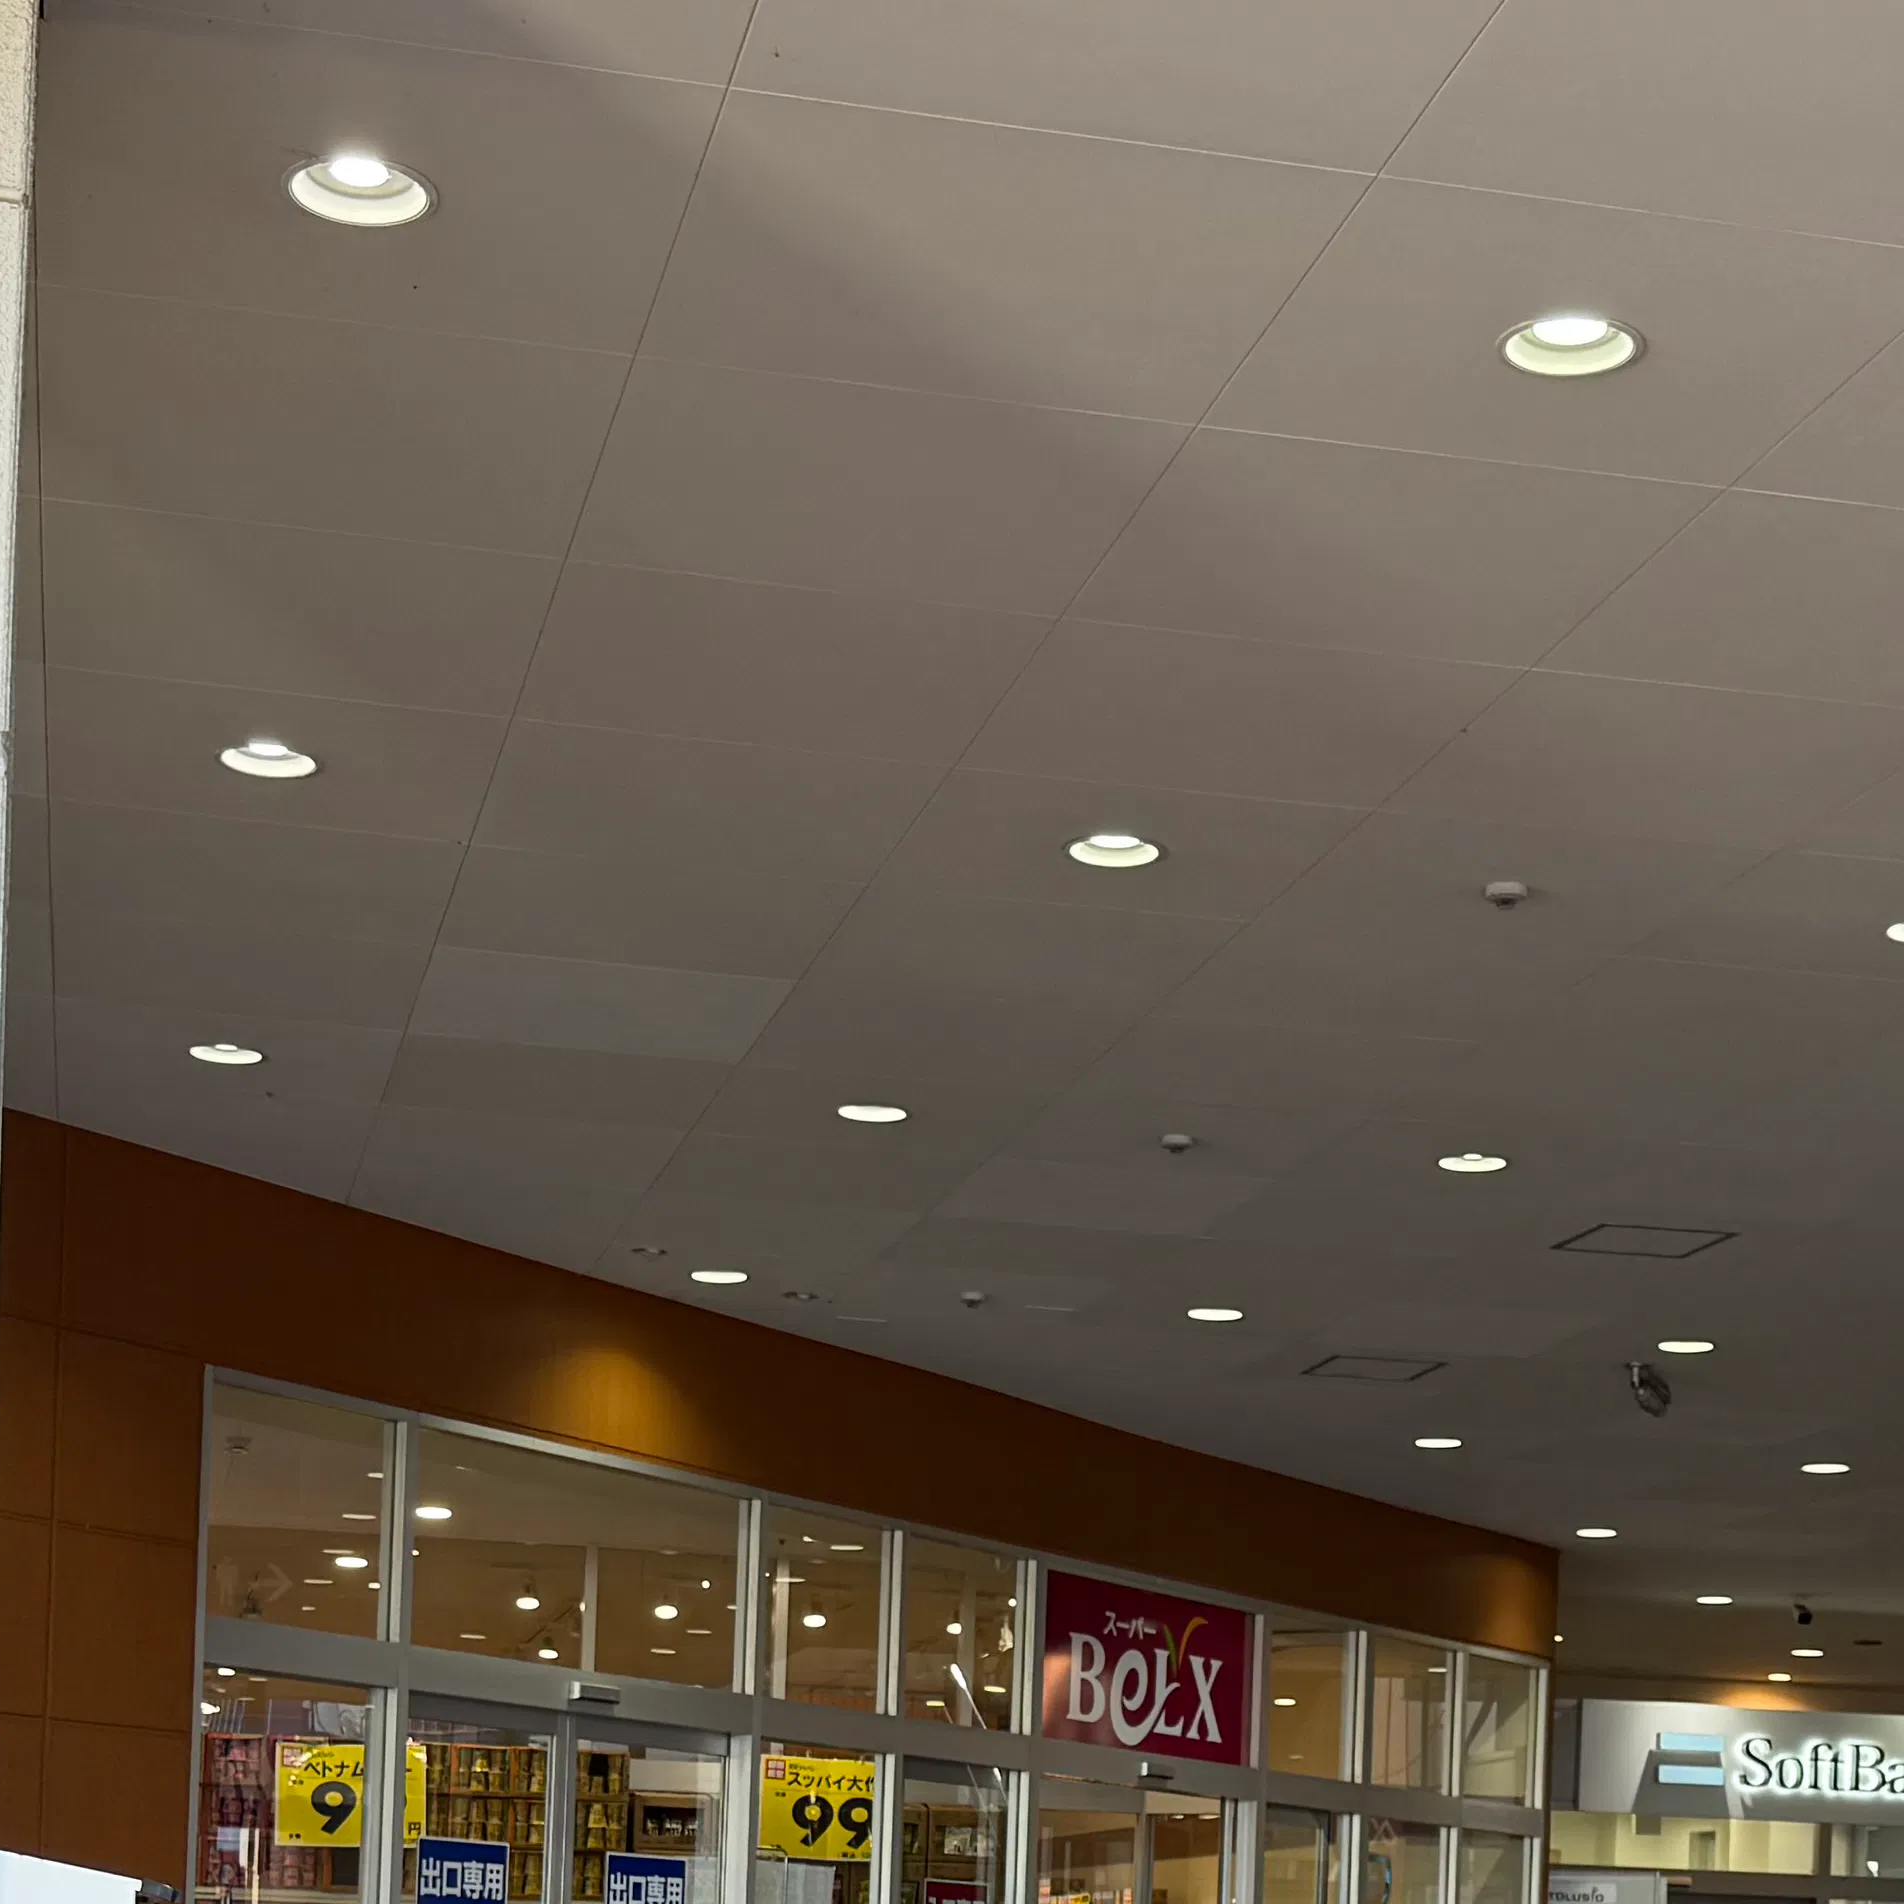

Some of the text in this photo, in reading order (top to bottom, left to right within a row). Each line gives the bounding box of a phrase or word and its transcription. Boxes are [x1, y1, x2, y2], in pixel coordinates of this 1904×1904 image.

[1103, 1610, 1157, 1640] スーパー
[792, 1794, 874, 1850] 99
[419, 1857, 504, 1901] 出口専用
